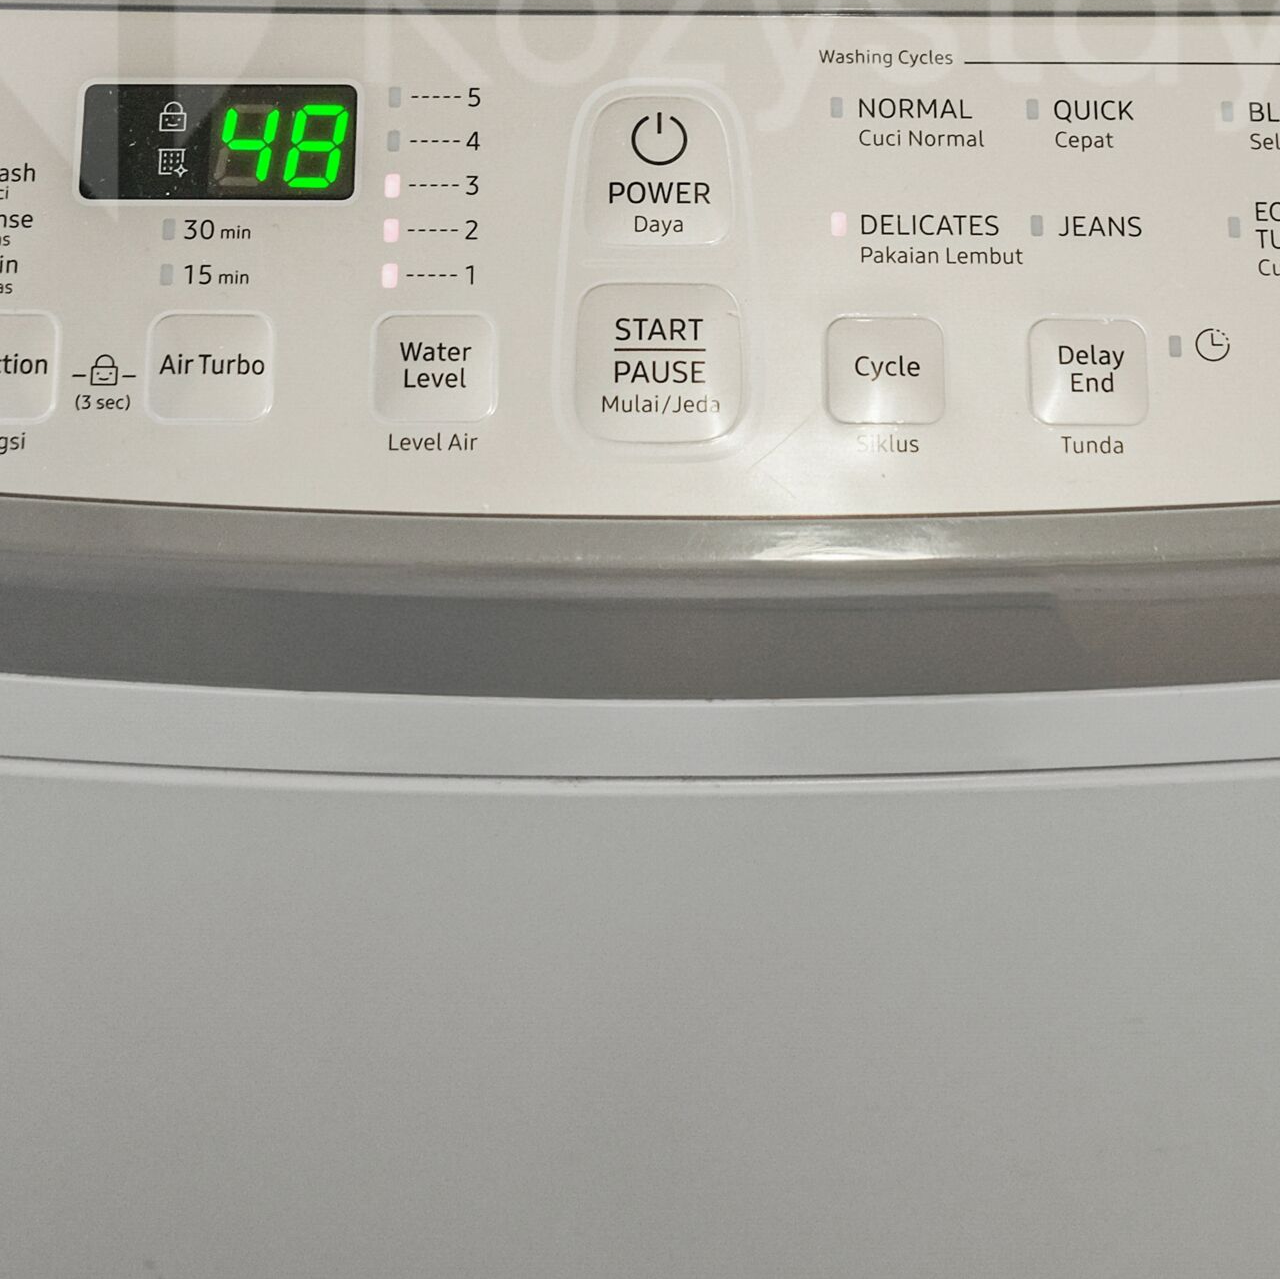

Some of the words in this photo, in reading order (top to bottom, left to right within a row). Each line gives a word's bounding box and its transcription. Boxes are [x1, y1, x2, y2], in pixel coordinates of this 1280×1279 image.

[819, 50, 892, 68] Washing
[899, 50, 953, 67] Cycles
[468, 88, 480, 107] 5
[859, 98, 972, 119] NORMAL
[1054, 100, 1133, 123] QUICK
[221, 104, 349, 188] 48
[466, 132, 480, 150] 4
[859, 130, 900, 146] Cuci
[909, 130, 984, 147] Normal
[1056, 131, 1113, 152] Cepat
[466, 176, 478, 195] 3
[609, 182, 710, 204] POWER
[184, 220, 214, 239] 30
[221, 225, 250, 239] min
[465, 220, 477, 240] 2
[635, 216, 683, 236] Daya
[861, 215, 999, 236] DELICATES
[1059, 216, 1142, 237] JEANS
[861, 246, 938, 264] Pakaian
[947, 247, 1023, 264] Lembut
[185, 265, 211, 284] 15
[219, 271, 249, 284] min
[466, 265, 473, 285] 1
[616, 318, 703, 340] START
[400, 342, 471, 361] Water
[1059, 345, 1124, 371] Delay
[160, 354, 194, 374] Air
[199, 354, 264, 375] Turbo
[615, 361, 705, 383] PAUSE
[855, 355, 920, 381] Cycle
[404, 368, 466, 388] Level
[1071, 372, 1113, 392] End
[76, 395, 90, 410] (3
[97, 395, 130, 410] sec)
[602, 395, 720, 414] Mulai/Jeda
[389, 433, 441, 451] Level
[448, 433, 478, 450] Air
[1061, 436, 1123, 454] Tunda
